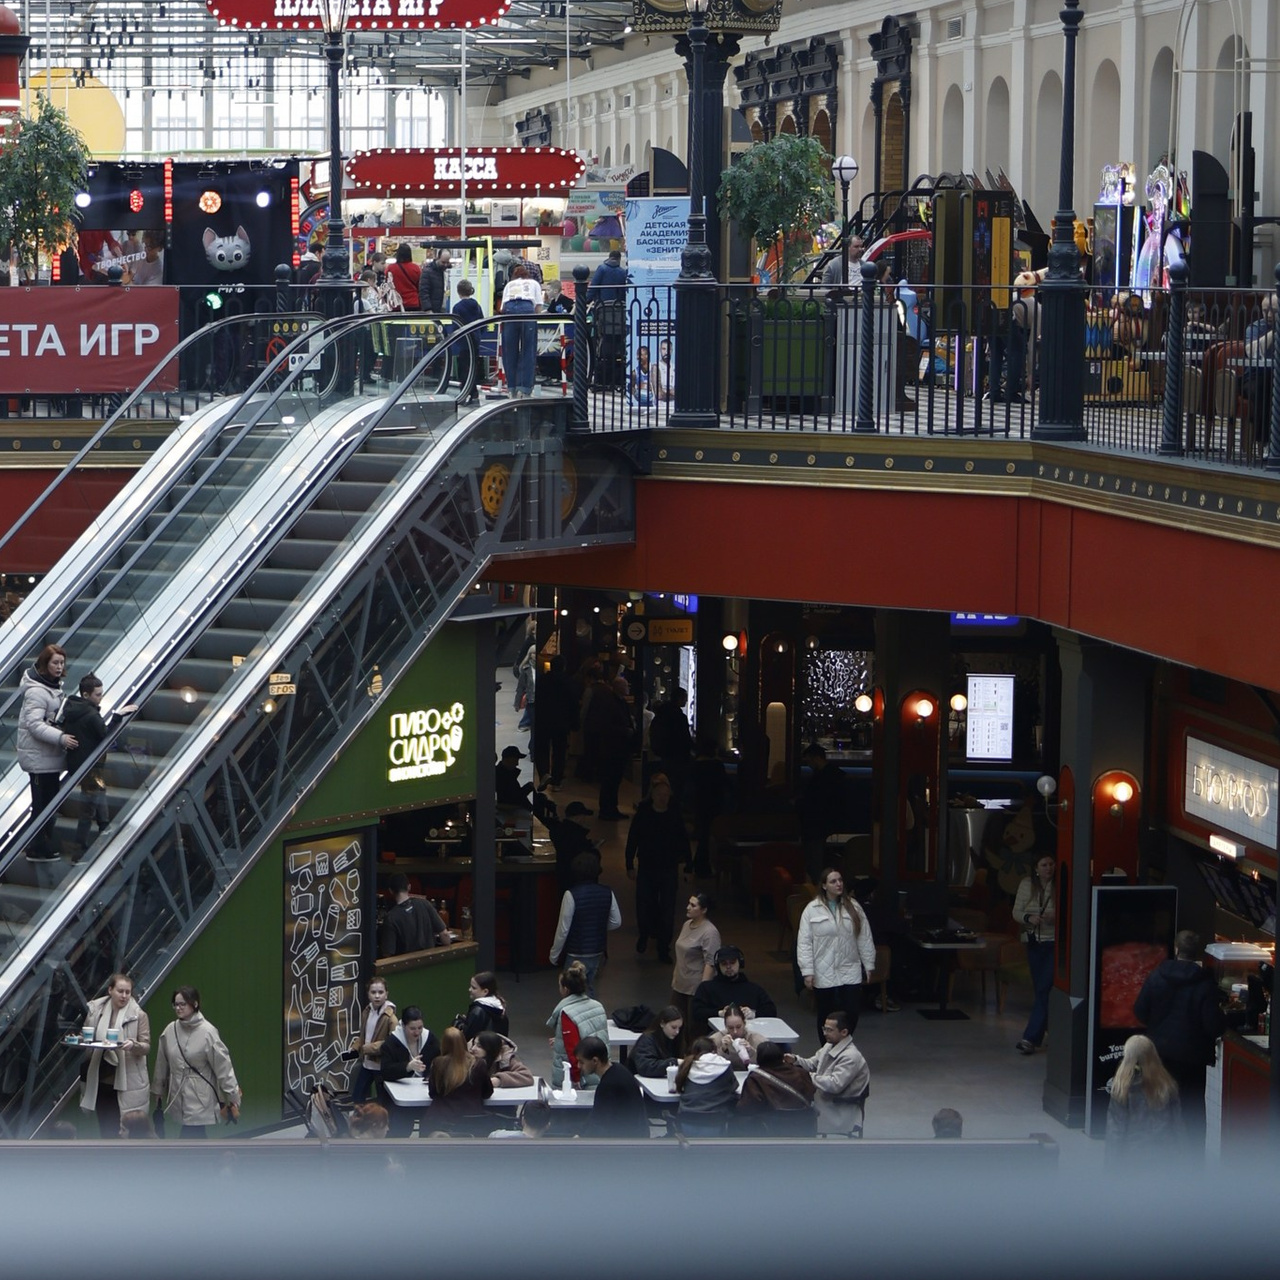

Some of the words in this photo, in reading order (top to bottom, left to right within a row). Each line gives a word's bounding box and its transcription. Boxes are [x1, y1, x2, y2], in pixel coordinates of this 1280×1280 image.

[433, 157, 498, 181] КАССА
[640, 229, 689, 238] АКАДЕМИЯ
[644, 221, 686, 229] ДЕТСКАЯ
[636, 238, 687, 246] БАСКЕТБОЛ
[95, 251, 147, 270] ТВОРЧЕСТВО
[80, 323, 160, 357] ИГР
[390, 708, 441, 738] ПИВО
[389, 733, 441, 767] СИДР
